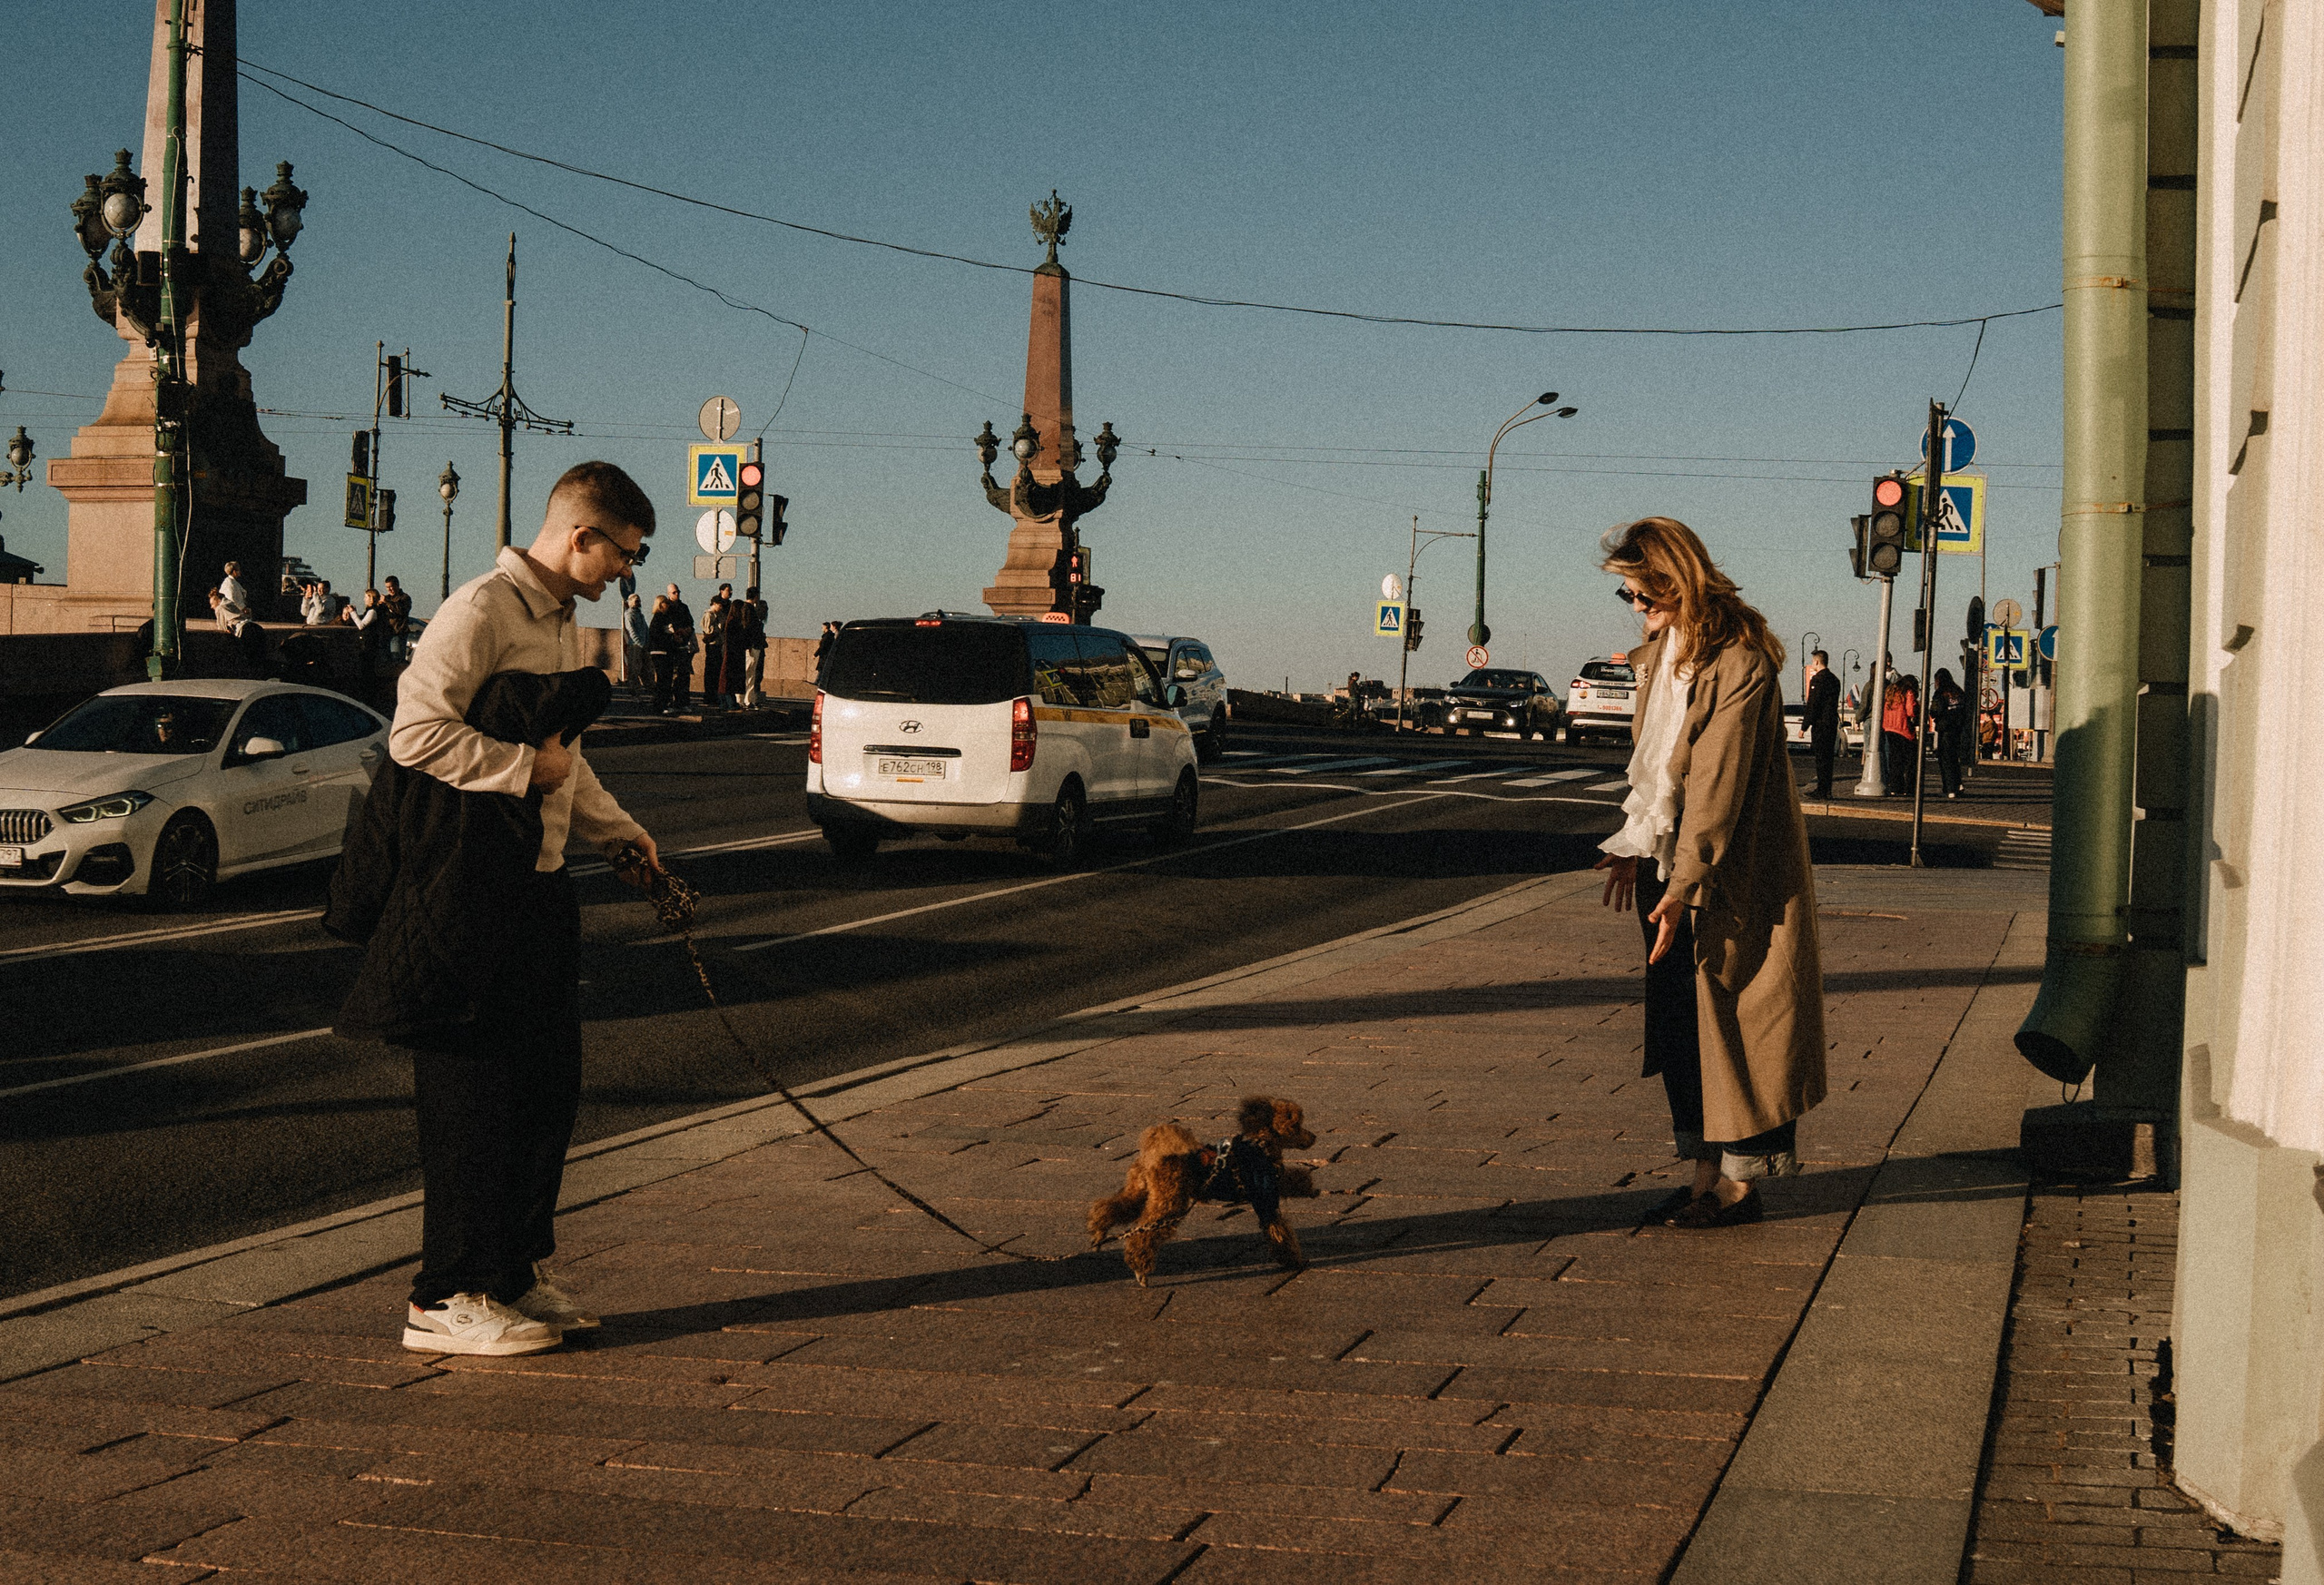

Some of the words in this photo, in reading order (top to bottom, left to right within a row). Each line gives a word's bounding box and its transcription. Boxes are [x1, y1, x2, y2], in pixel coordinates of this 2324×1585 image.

[882, 762, 924, 773] Е762СН
[926, 762, 942, 771] 198
[243, 788, 308, 815] СИТИДРАЙВ
